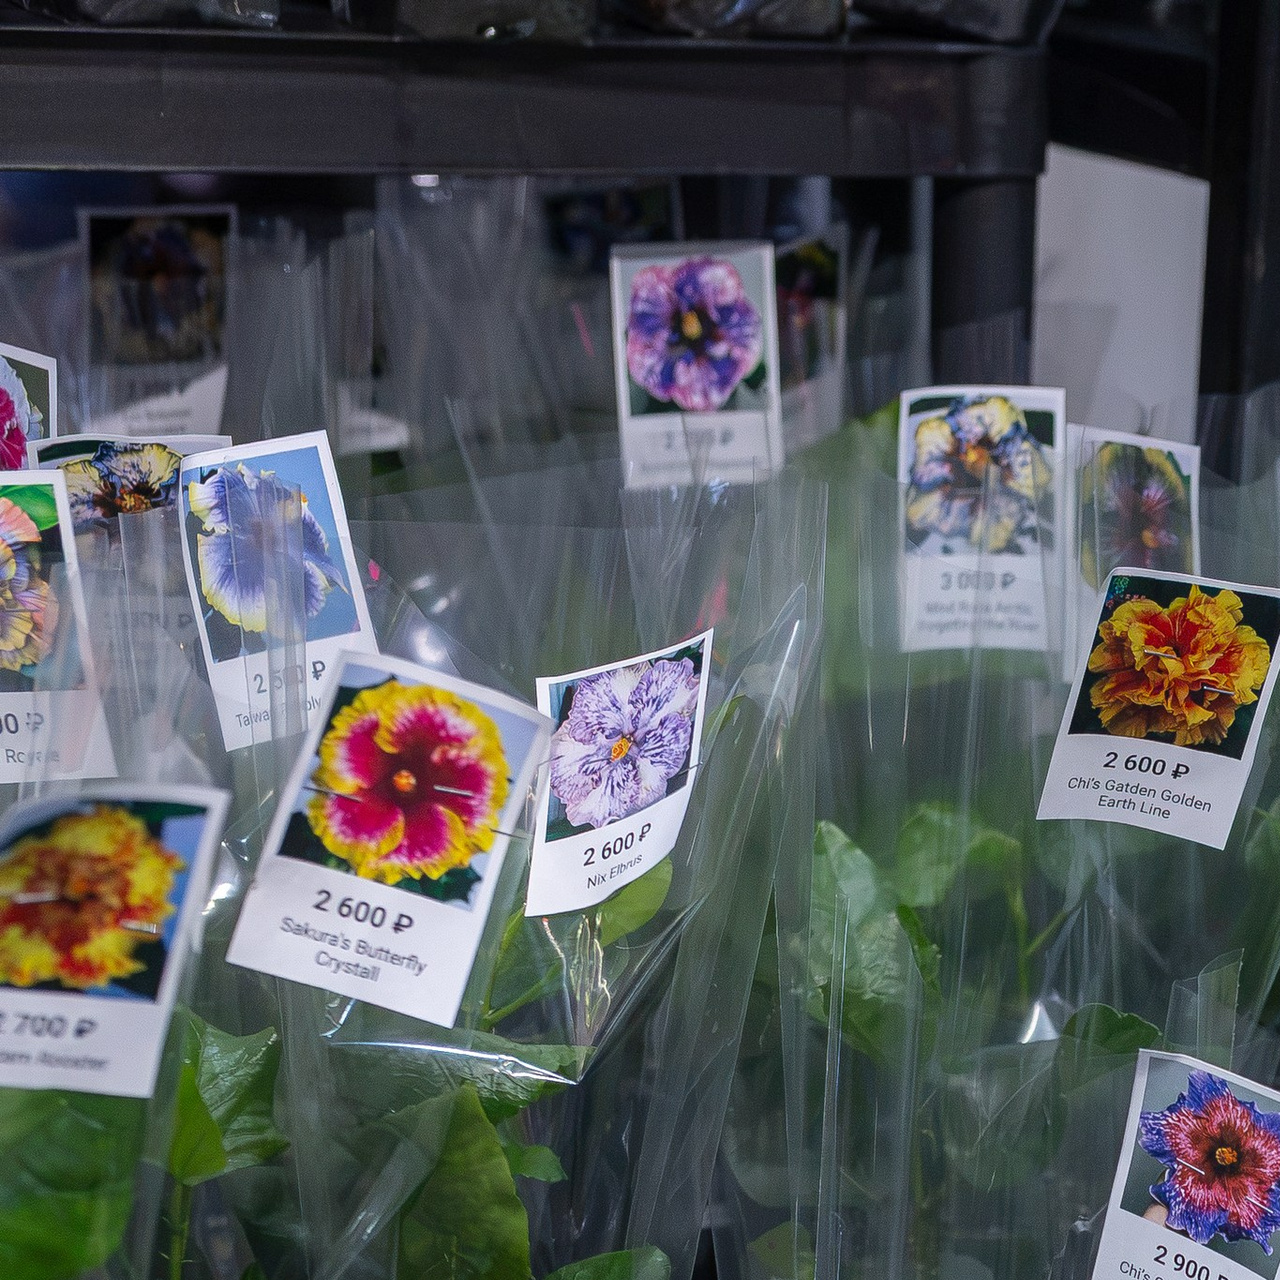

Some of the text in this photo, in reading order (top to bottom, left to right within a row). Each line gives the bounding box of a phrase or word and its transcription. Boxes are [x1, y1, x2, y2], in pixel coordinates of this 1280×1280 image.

[253, 673, 268, 694] 2
[311, 660, 326, 681] ₽
[235, 709, 271, 728] Taiwa
[1103, 751, 1190, 780] 2 600 ₽
[1067, 776, 1212, 813] Chi's Gatden Golden
[1098, 794, 1171, 820] Earth Line
[582, 822, 652, 867] 2 600 ₽
[587, 854, 643, 889] Nix Elbrus
[313, 888, 414, 934] 2 600 ₽
[280, 916, 428, 977] Sakura's Butterfly
[314, 950, 381, 982] Crystall
[14, 1011, 68, 1039] 700
[1153, 1244, 1168, 1265] 2
